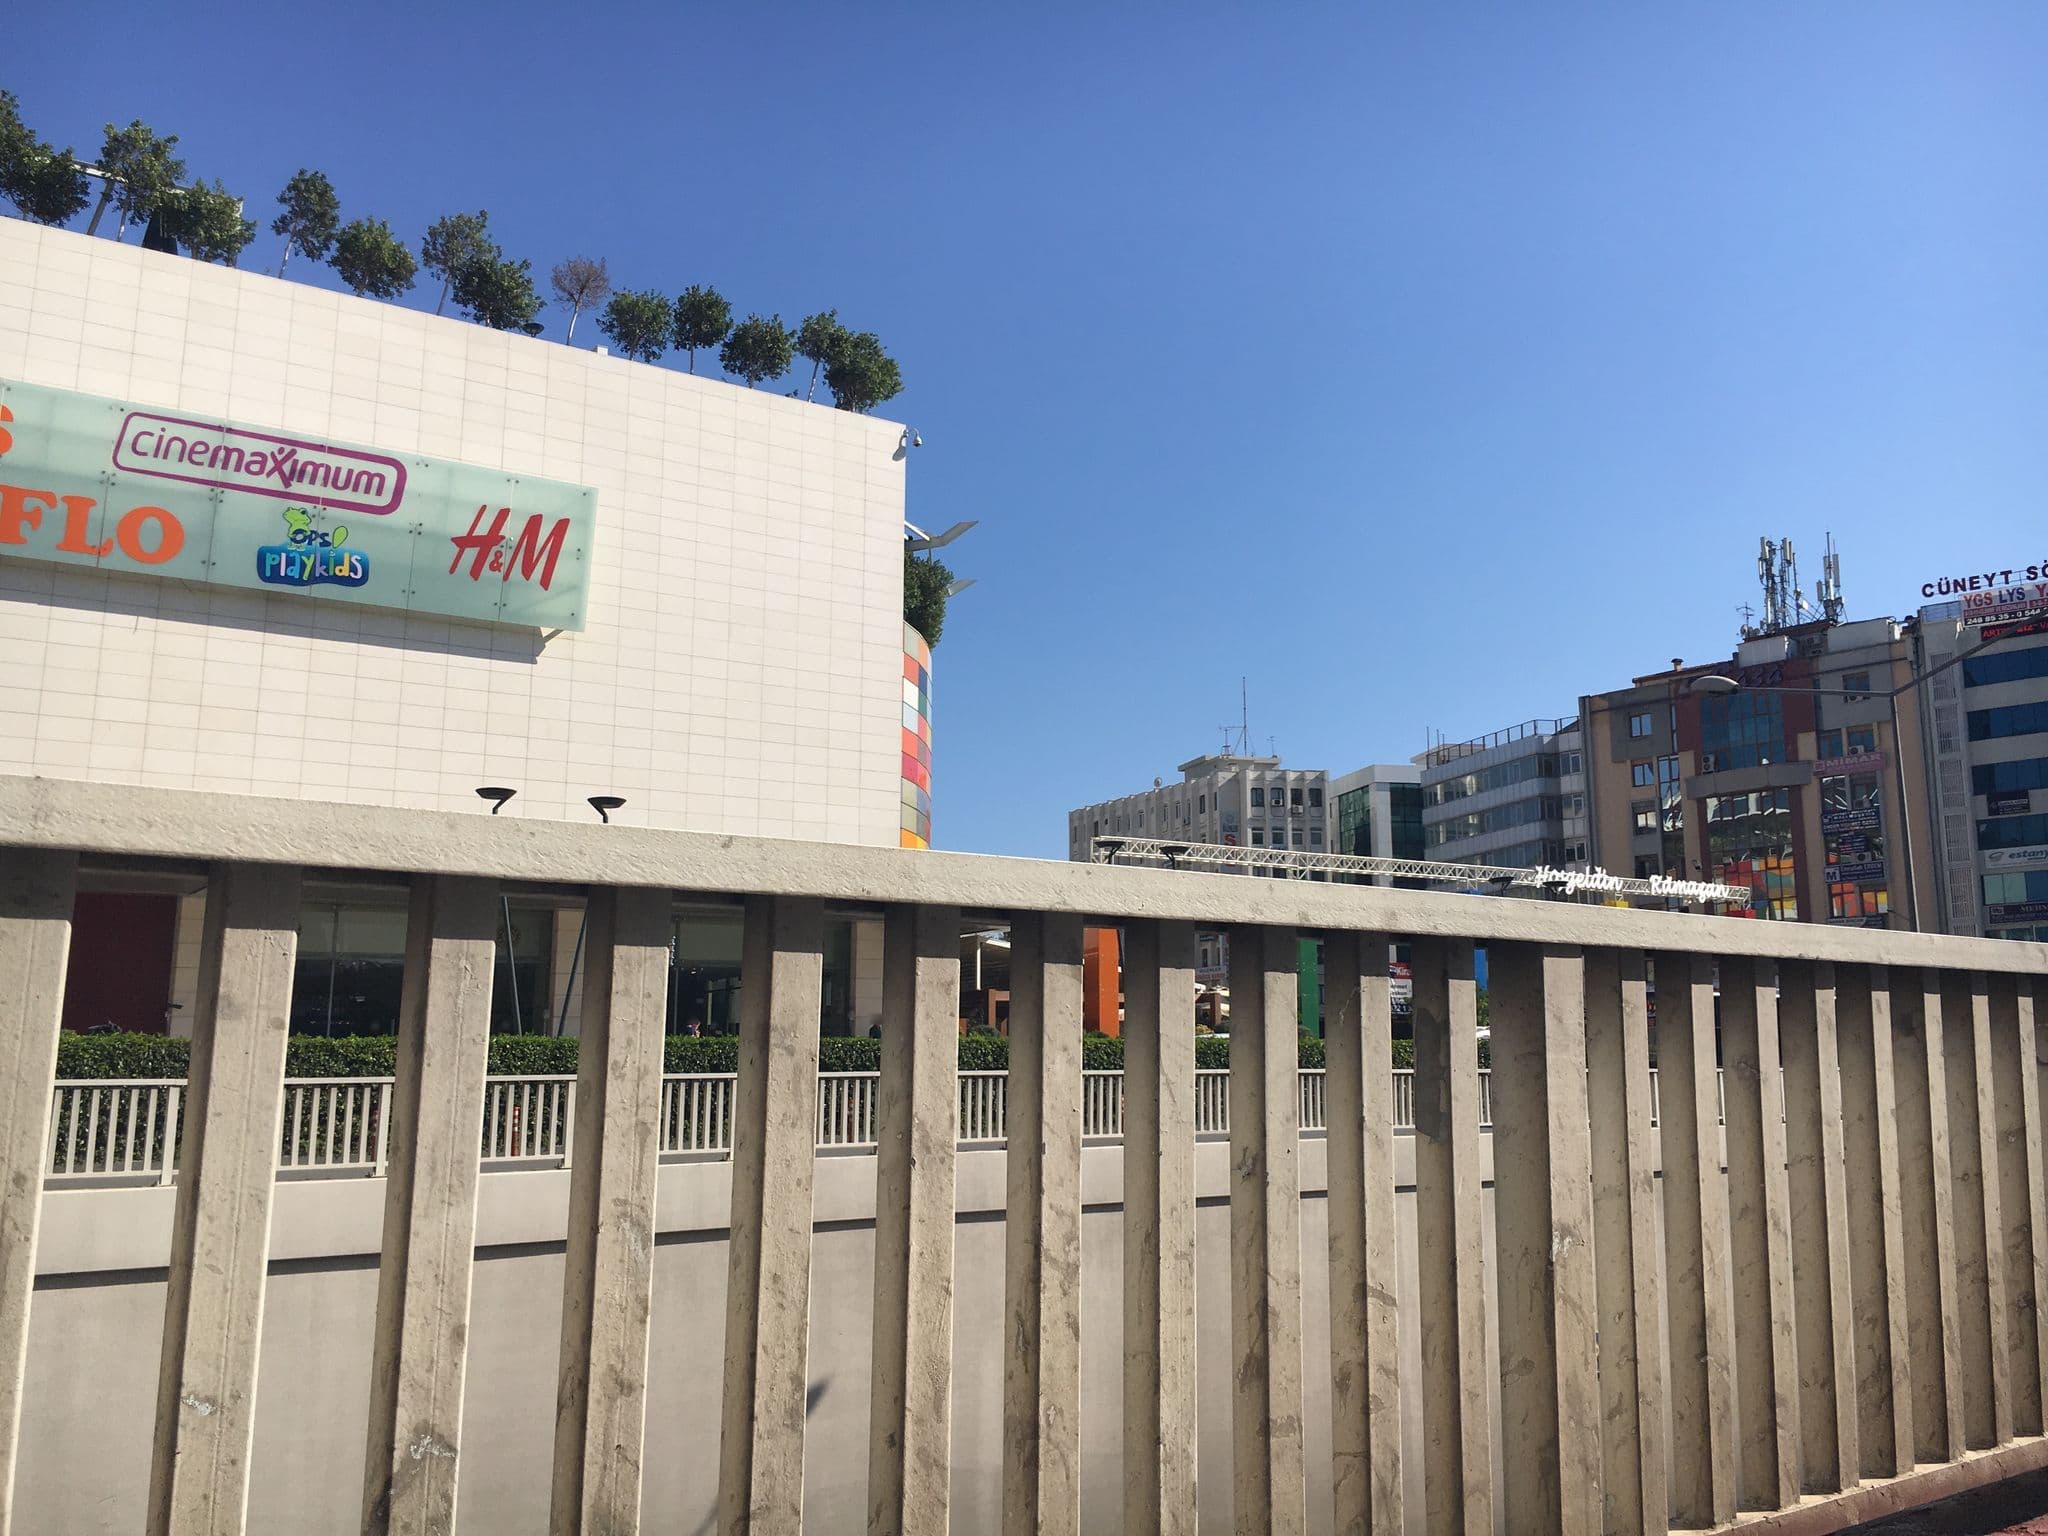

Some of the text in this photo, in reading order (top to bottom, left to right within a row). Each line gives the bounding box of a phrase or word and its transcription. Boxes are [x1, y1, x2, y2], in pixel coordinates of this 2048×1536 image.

[0, 484, 185, 564] FLO
[449, 505, 570, 591] H&M
[1922, 569, 2012, 598] CÜNEYT
[1964, 591, 1993, 609] YGS
[1999, 587, 2026, 604] LYS
